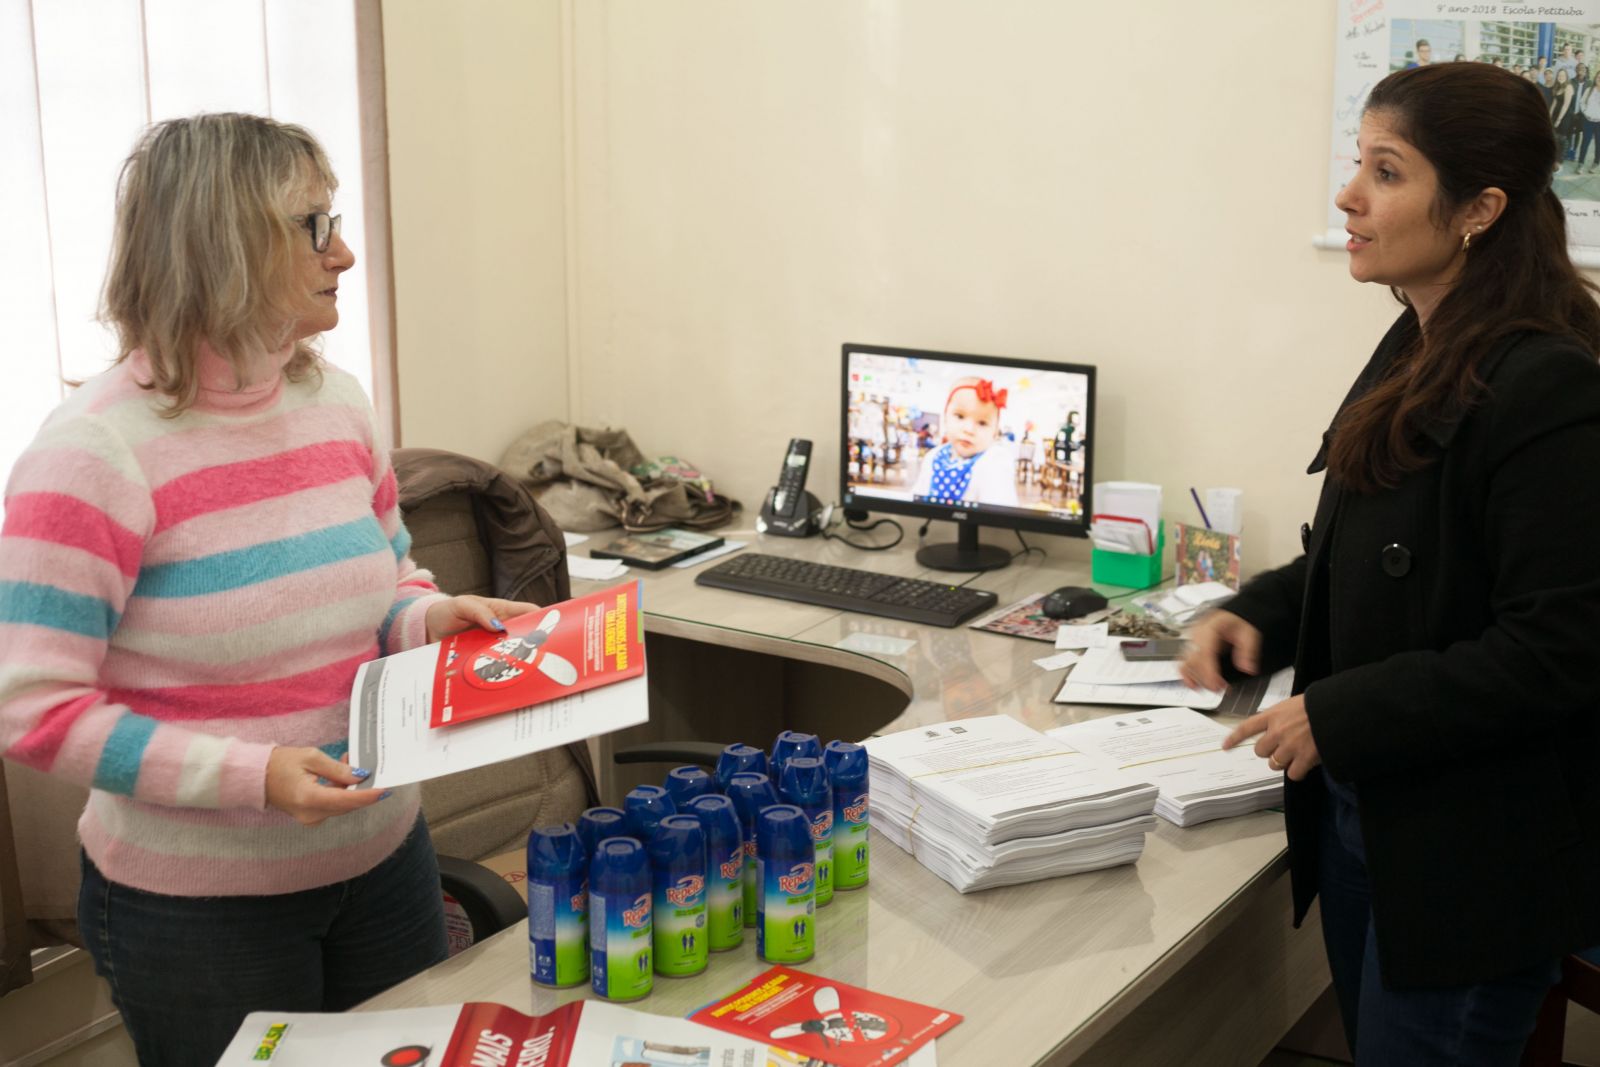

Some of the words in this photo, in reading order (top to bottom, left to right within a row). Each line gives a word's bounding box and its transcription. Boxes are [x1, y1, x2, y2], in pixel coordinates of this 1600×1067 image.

[1448, 6, 1470, 14] ano
[1472, 5, 1496, 14] 2018
[1502, 5, 1536, 15] Escola
[1538, 6, 1584, 16] Petituba
